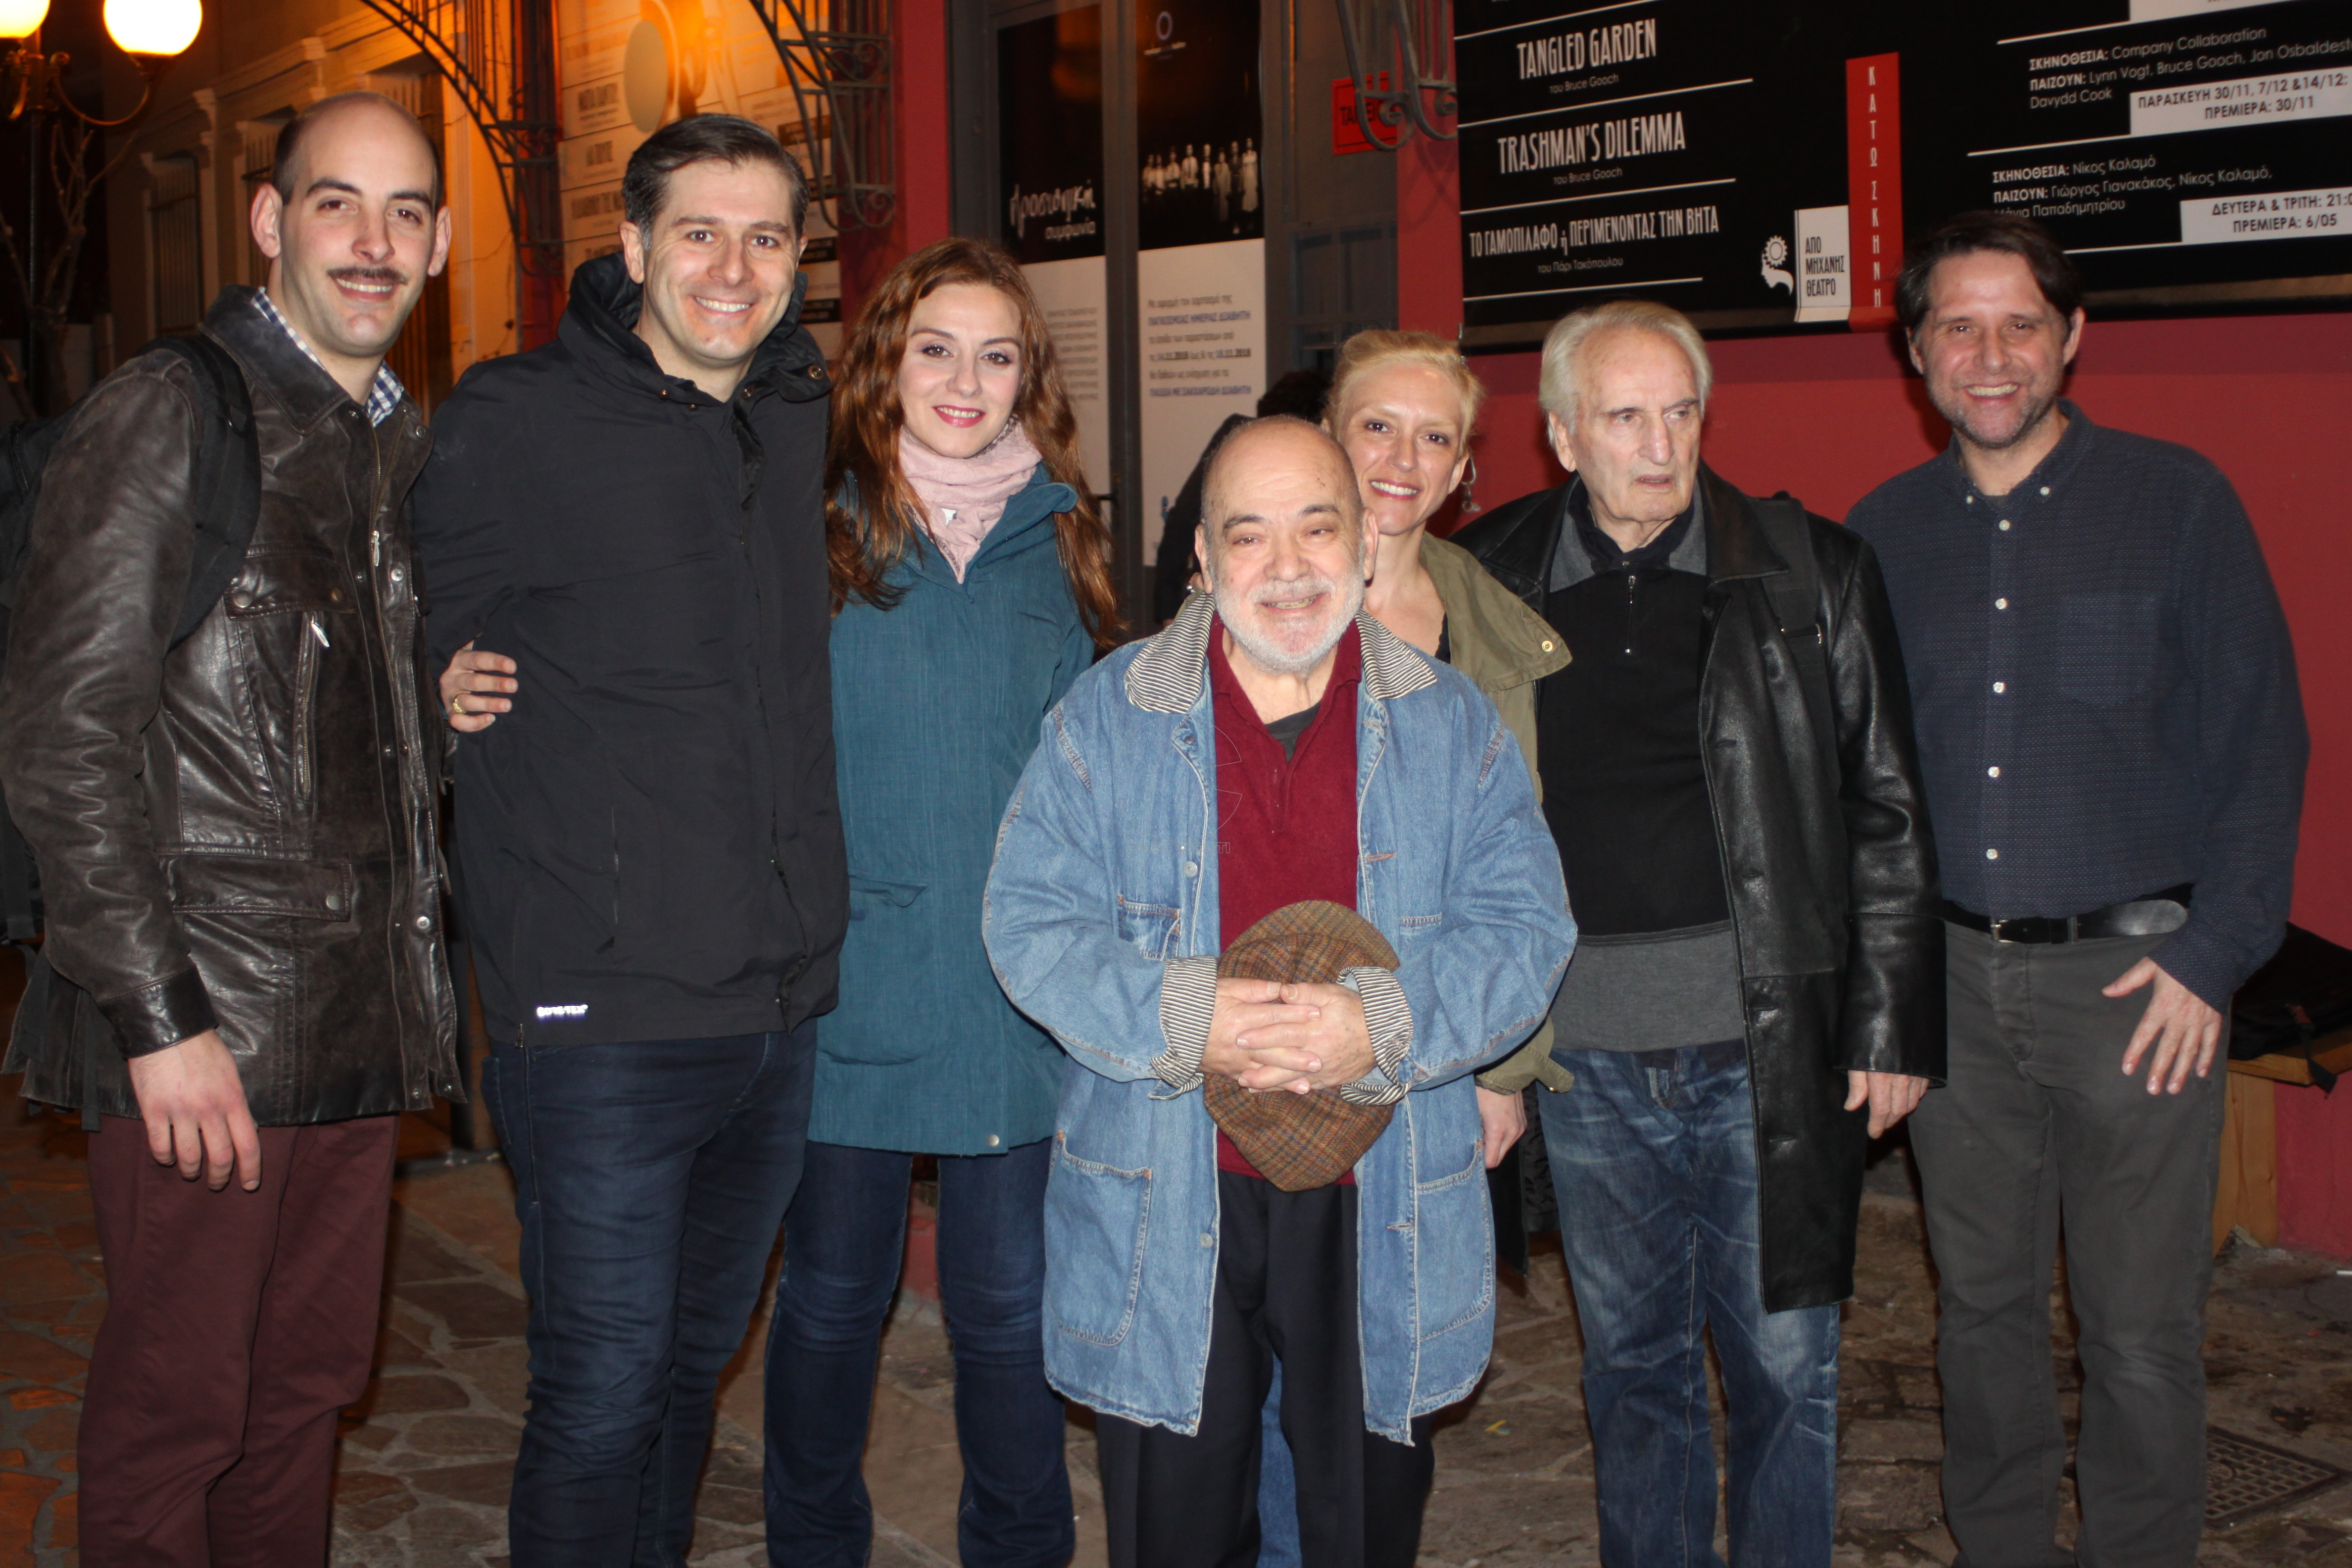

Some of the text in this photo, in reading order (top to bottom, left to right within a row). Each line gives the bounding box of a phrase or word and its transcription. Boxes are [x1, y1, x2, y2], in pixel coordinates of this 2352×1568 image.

[1517, 18, 1657, 80] TANGLED GARDEN
[2029, 27, 2267, 71] ΣΚΗΝΟΘΕΣΙΑ: Company Collaboration
[2030, 73, 2086, 91] ΠΑΙΖΟΥΝ:
[2089, 70, 2117, 85] Lynn
[2157, 59, 2193, 74] Bruce
[2197, 51, 2246, 69] Gooch,
[2250, 49, 2273, 63] Jon
[2278, 38, 2352, 59] Osbaldest
[1549, 73, 1619, 94] του Bruce Gooch
[2139, 87, 2211, 108] ΠΑΡΑΣΚΕΥΗ
[2259, 79, 2288, 95] 7/12
[2030, 87, 2113, 109] Davydd Cook
[2205, 95, 2314, 119] ΠΡΕΜΙΕΡΑ: 30/11
[1604, 111, 1686, 160] DILEMMA
[1553, 166, 1622, 185] του Bruce Gooch
[1992, 164, 2070, 184] ΣΚΗΝΟΘΕΣΙΑ:
[2108, 154, 2156, 172] Καλαμό
[1993, 187, 2049, 203] ΠΑΙΖΟΥΝ:
[2052, 184, 2100, 199] Γιώργος
[2033, 198, 2126, 217] Παπαδημητρίου
[2212, 199, 2267, 216] ΔΕΥΤΕΡΑ
[2271, 199, 2280, 211] &
[2283, 195, 2322, 210] ΤΡΙΤΗ:
[1469, 231, 1483, 257] ΤΟ
[1484, 222, 1558, 256] ΓΑΜΟΠΙΛΑΦΟ
[1569, 211, 1657, 246] ΠΕΡΙΜΕΝΟΝΤΑΣ
[1659, 208, 1684, 238] ΤΗΝ
[1685, 205, 1720, 235] ΒΗΤΑ
[2233, 213, 2338, 233] ΠΡΕΜΙΕΡΑ: 6/05
[1806, 236, 1822, 254] ΑΠΟ
[1806, 255, 1845, 275] ΜΗΧΑΝΗΣ
[1807, 278, 1836, 297] ΘΕΑΤΡΟ
